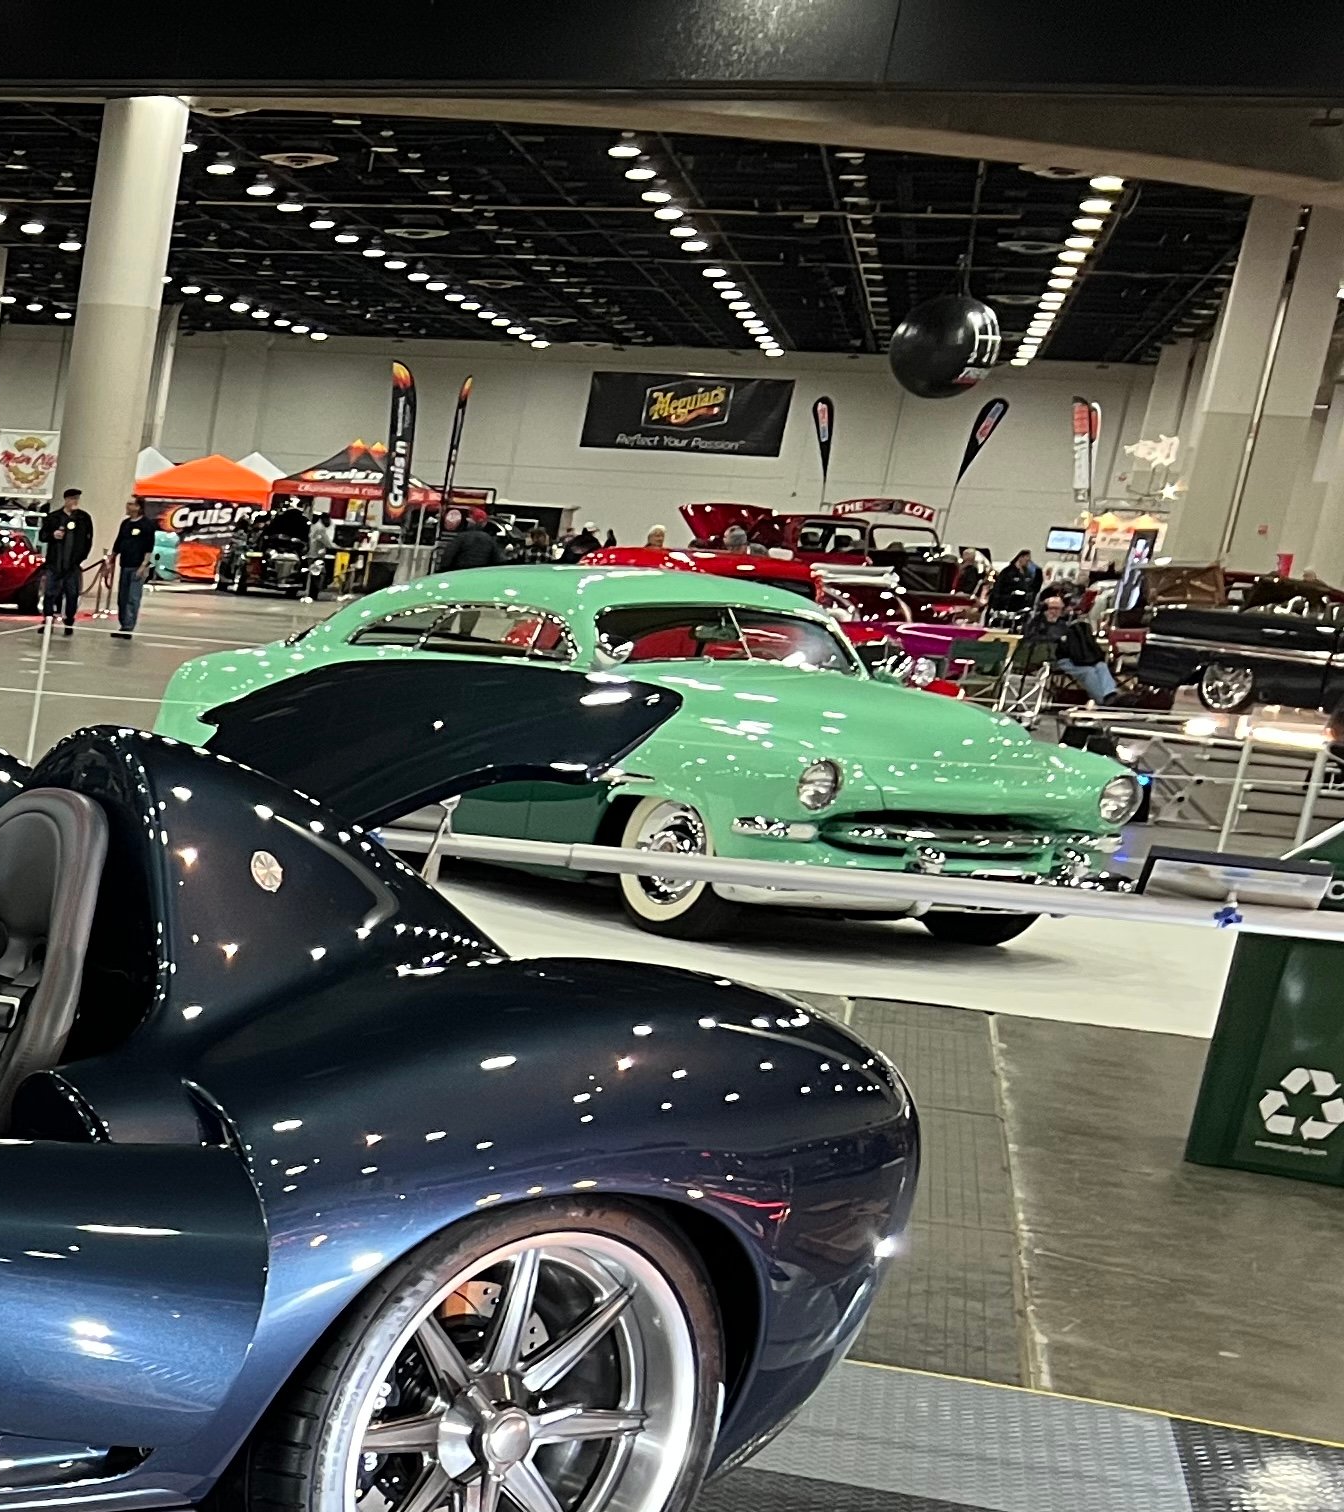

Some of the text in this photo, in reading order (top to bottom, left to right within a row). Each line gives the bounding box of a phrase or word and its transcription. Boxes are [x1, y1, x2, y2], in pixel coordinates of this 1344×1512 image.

[662, 435, 690, 447] Your
[835, 502, 934, 518] THE LOT
